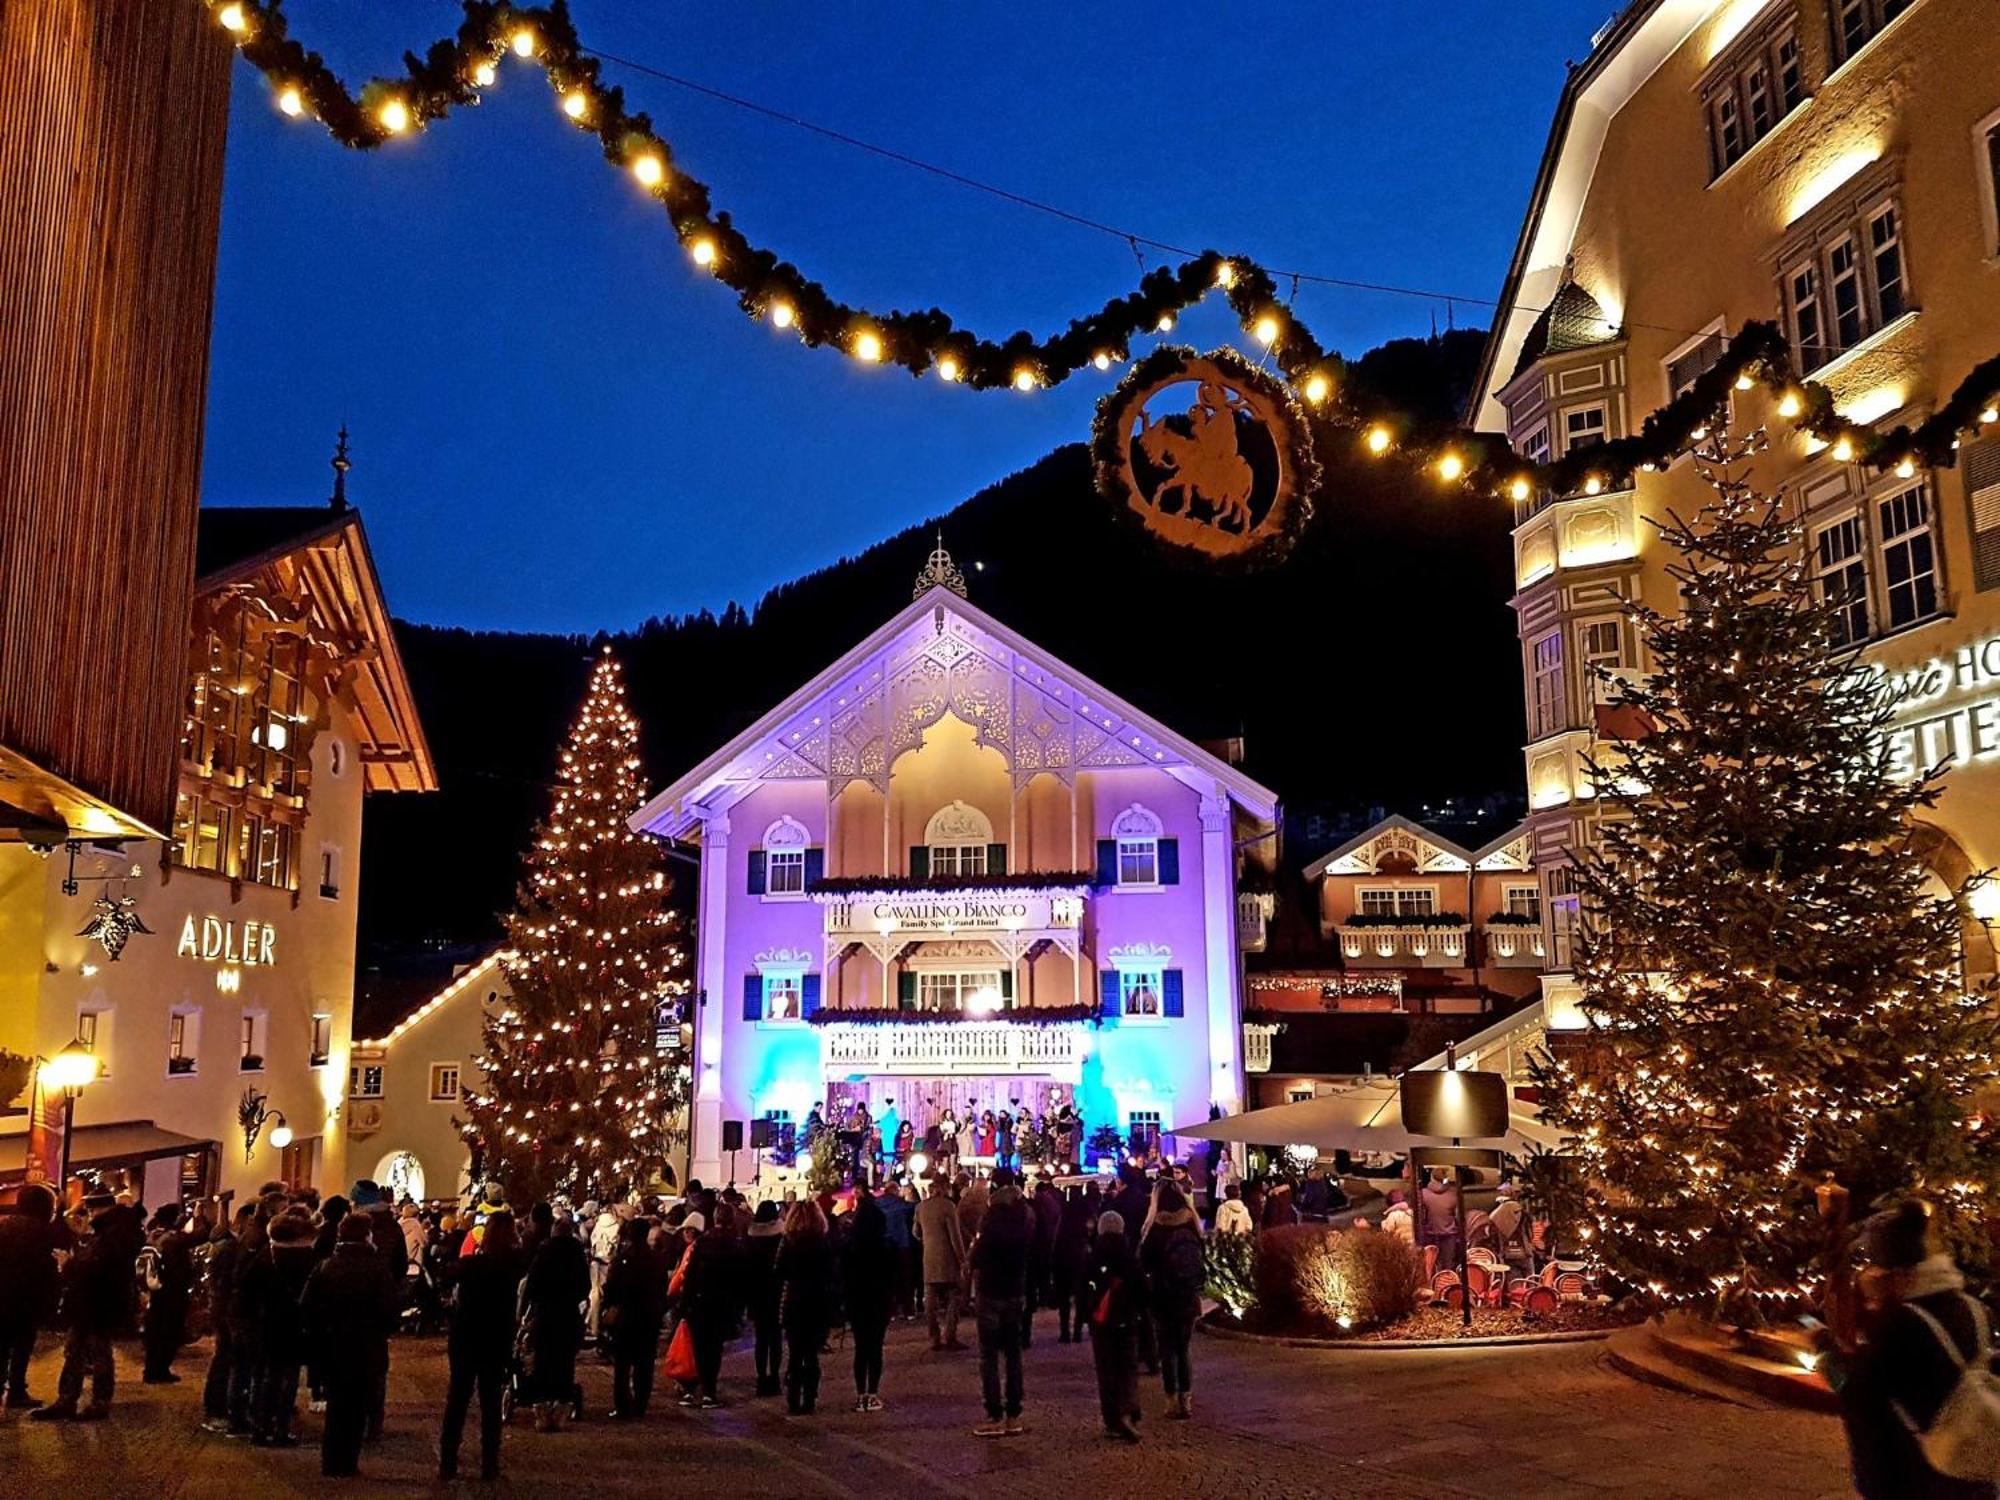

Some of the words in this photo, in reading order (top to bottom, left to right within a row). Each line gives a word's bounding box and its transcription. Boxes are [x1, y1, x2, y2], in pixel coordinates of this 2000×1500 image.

[177, 914, 276, 965] ADLER
[900, 919, 928, 930] Family
[976, 917, 999, 927] Hotel
